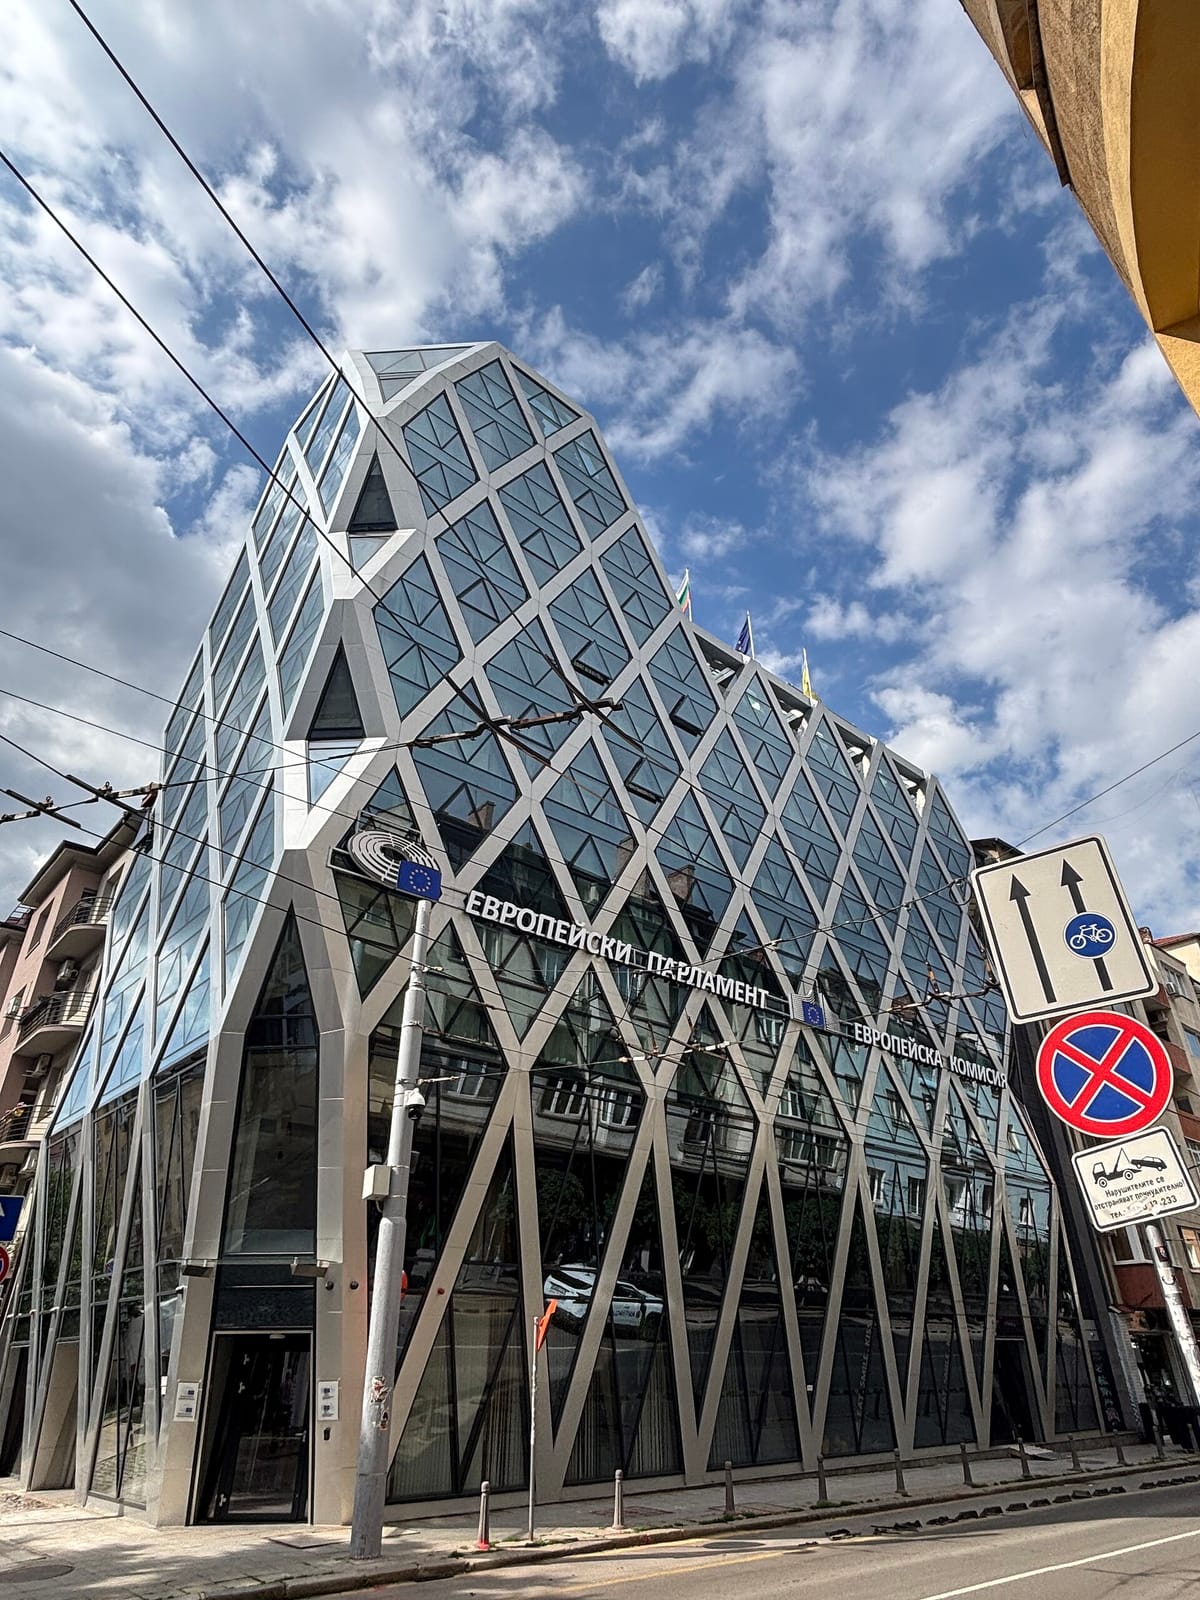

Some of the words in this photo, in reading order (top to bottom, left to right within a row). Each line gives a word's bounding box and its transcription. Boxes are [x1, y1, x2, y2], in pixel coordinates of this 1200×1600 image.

[465, 889, 633, 965] ЕВРОПЕЙСКИ
[648, 950, 770, 1009] ПАРЛАМЕНТ
[854, 1023, 943, 1068] ЕВРОПЕЙСКА
[950, 1056, 1008, 1089] КОМИСИЯ
[1105, 1180, 1154, 1197] Нарушителите
[1155, 1175, 1165, 1184] се
